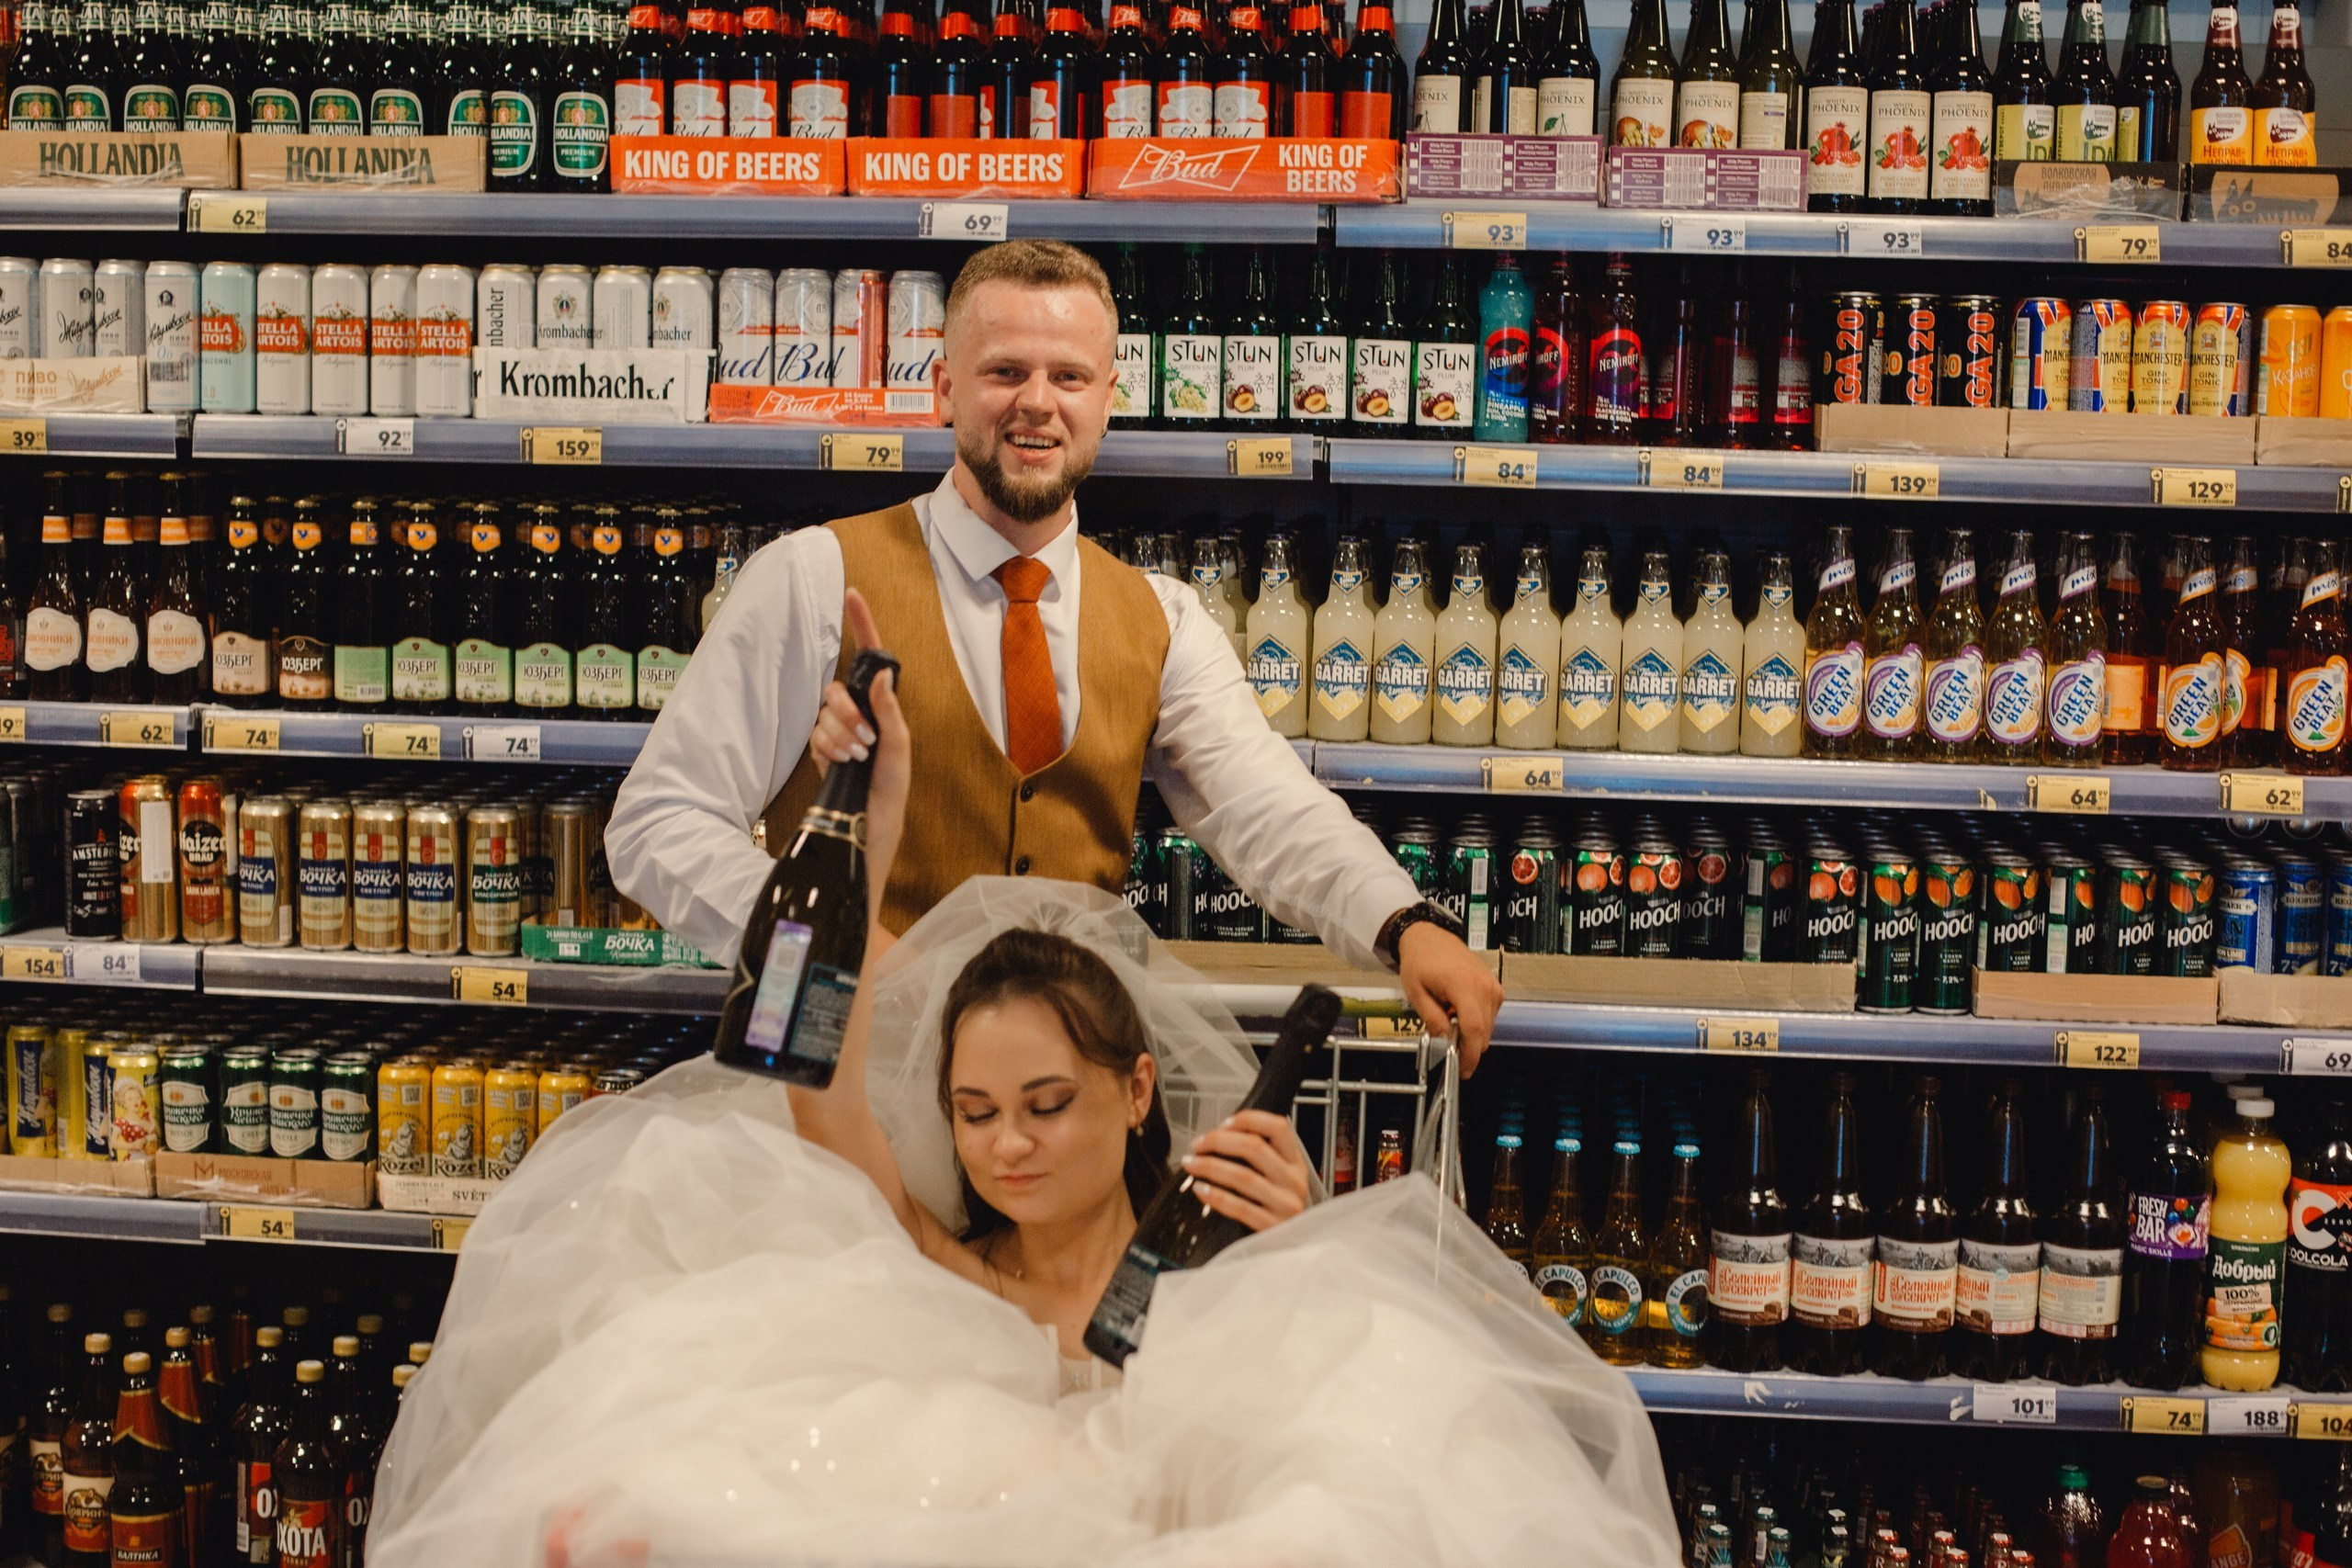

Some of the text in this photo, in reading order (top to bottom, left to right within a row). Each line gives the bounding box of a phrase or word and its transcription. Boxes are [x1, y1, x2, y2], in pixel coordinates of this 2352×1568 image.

[1540, 94, 1586, 106] PHOENIX
[1619, 95, 1664, 107] PHOENIX
[1685, 97, 1734, 110] PHOENIX
[1813, 103, 1861, 115] PHOENIX
[1878, 107, 1928, 118] PHOENIX
[1941, 107, 1990, 118] PHOENIX
[554, 128, 607, 142] HOLLANDIA
[39, 141, 184, 178] HOLLANDIA
[560, 148, 595, 157] PREMIUM
[1279, 144, 1368, 168] KING OF
[286, 145, 435, 185] HOLLANDIA
[626, 150, 820, 181] KING OF BEERS
[865, 152, 1064, 182] KING OF BEERS
[1144, 149, 1224, 183] Bud
[2041, 166, 2098, 180] ВОЛКОВСКАЯ
[1286, 170, 1357, 194] BEERS
[232, 209, 256, 227] 62
[965, 214, 992, 231] 69
[1487, 224, 1514, 242] 93
[1706, 229, 1734, 245] 93
[1883, 231, 1911, 249] 93
[2121, 238, 2147, 255] 79
[2326, 243, 2352, 259] 84
[257, 322, 299, 335] STELLA
[315, 323, 362, 335] STELLA
[372, 324, 415, 337] STELLA
[421, 324, 468, 338] STELLA
[257, 334, 299, 347] ARTOIS
[315, 335, 362, 348] ARTOIS
[372, 337, 416, 350] ARTOIS
[421, 337, 468, 350] ARTOIS
[1172, 338, 1218, 364] STUN
[1227, 340, 1272, 364] STUN
[1295, 340, 1342, 365] STUN
[1359, 344, 1406, 367] STUN
[1423, 346, 1470, 371] STUN
[2133, 352, 2183, 367] MANCHESTER
[1489, 351, 1529, 370] NEMIROFF
[1599, 353, 1639, 373] NEMIROFF
[16, 370, 58, 384] ПИВО
[770, 393, 817, 414] Bud
[13, 431, 36, 446] 39
[379, 430, 402, 446] 92
[556, 440, 590, 457] 159
[865, 446, 891, 463] 79
[1257, 451, 1283, 464] 199
[1498, 462, 1525, 479] 84
[1683, 467, 1711, 483] 84
[1890, 475, 1926, 493] 139
[2188, 480, 2223, 499] 129
[1827, 563, 1854, 583] mix
[1890, 564, 1916, 584] mix
[1945, 562, 1973, 583] mix
[2008, 566, 2035, 587] mix
[2071, 569, 2097, 589] mix
[2188, 572, 2215, 593] mix
[2311, 576, 2338, 596] mix
[524, 663, 565, 681] ЮЗБЕРГ
[1247, 660, 1300, 682] GARRET
[1315, 663, 1369, 683] GARRET
[1375, 666, 1430, 687] GARRET
[1438, 669, 1493, 690] GARRET
[1561, 672, 1614, 694] GARRET
[1623, 673, 1679, 694] GARRET
[1682, 676, 1736, 697] GARRET
[1747, 678, 1803, 699] GARRET
[1811, 664, 1851, 717] GREEN
[1869, 666, 1910, 718] GREEN
[1828, 682, 1854, 717] BEAT
[1886, 684, 1912, 719] BEAT
[1930, 669, 1969, 723] GREEN
[1946, 686, 1972, 723] BEAT
[1991, 671, 2029, 725] GREEN
[2054, 673, 2094, 728] GREEN
[2168, 676, 2208, 728] GREEN
[2007, 689, 2033, 725] BEAT
[2073, 691, 2098, 726] BEAT
[2183, 694, 2212, 729] BEAT
[2292, 680, 2333, 732] GREEN
[2309, 696, 2335, 733] BEAT
[140, 724, 164, 740] 62
[246, 728, 268, 745] 74
[405, 736, 429, 751] 74
[505, 738, 529, 752] 74
[1524, 770, 1552, 786] 64
[2070, 789, 2098, 806] 64
[2265, 789, 2291, 806] 62
[300, 868, 347, 885] БОЧКА
[354, 870, 401, 886] БОЧКА
[408, 872, 455, 889] БОЧКА
[472, 874, 520, 890] БОЧКА
[1630, 898, 1681, 931] HOOCH
[1993, 910, 2046, 945] HOOCH
[604, 934, 655, 952] БОЧКА
[25, 958, 55, 976] 154
[103, 953, 127, 970] 84
[492, 982, 516, 998] 54
[1390, 1016, 1424, 1032] 129
[1731, 1030, 1767, 1047] 134
[2094, 1045, 2127, 1063] 122
[2324, 1052, 2352, 1068] 69
[2138, 1195, 2168, 1220] FRESH
[261, 1220, 284, 1235] 54
[2136, 1217, 2166, 1244] BAR
[2148, 1247, 2173, 1258] SKILLS
[2211, 1254, 2277, 1283] Добрый
[1544, 1267, 1585, 1293] CAPULCO
[1596, 1270, 1640, 1296] CAPULCO
[2224, 1288, 2260, 1301] 100%
[2011, 1397, 2045, 1415] 101
[2167, 1411, 2192, 1427] 74
[2244, 1411, 2279, 1426] 188
